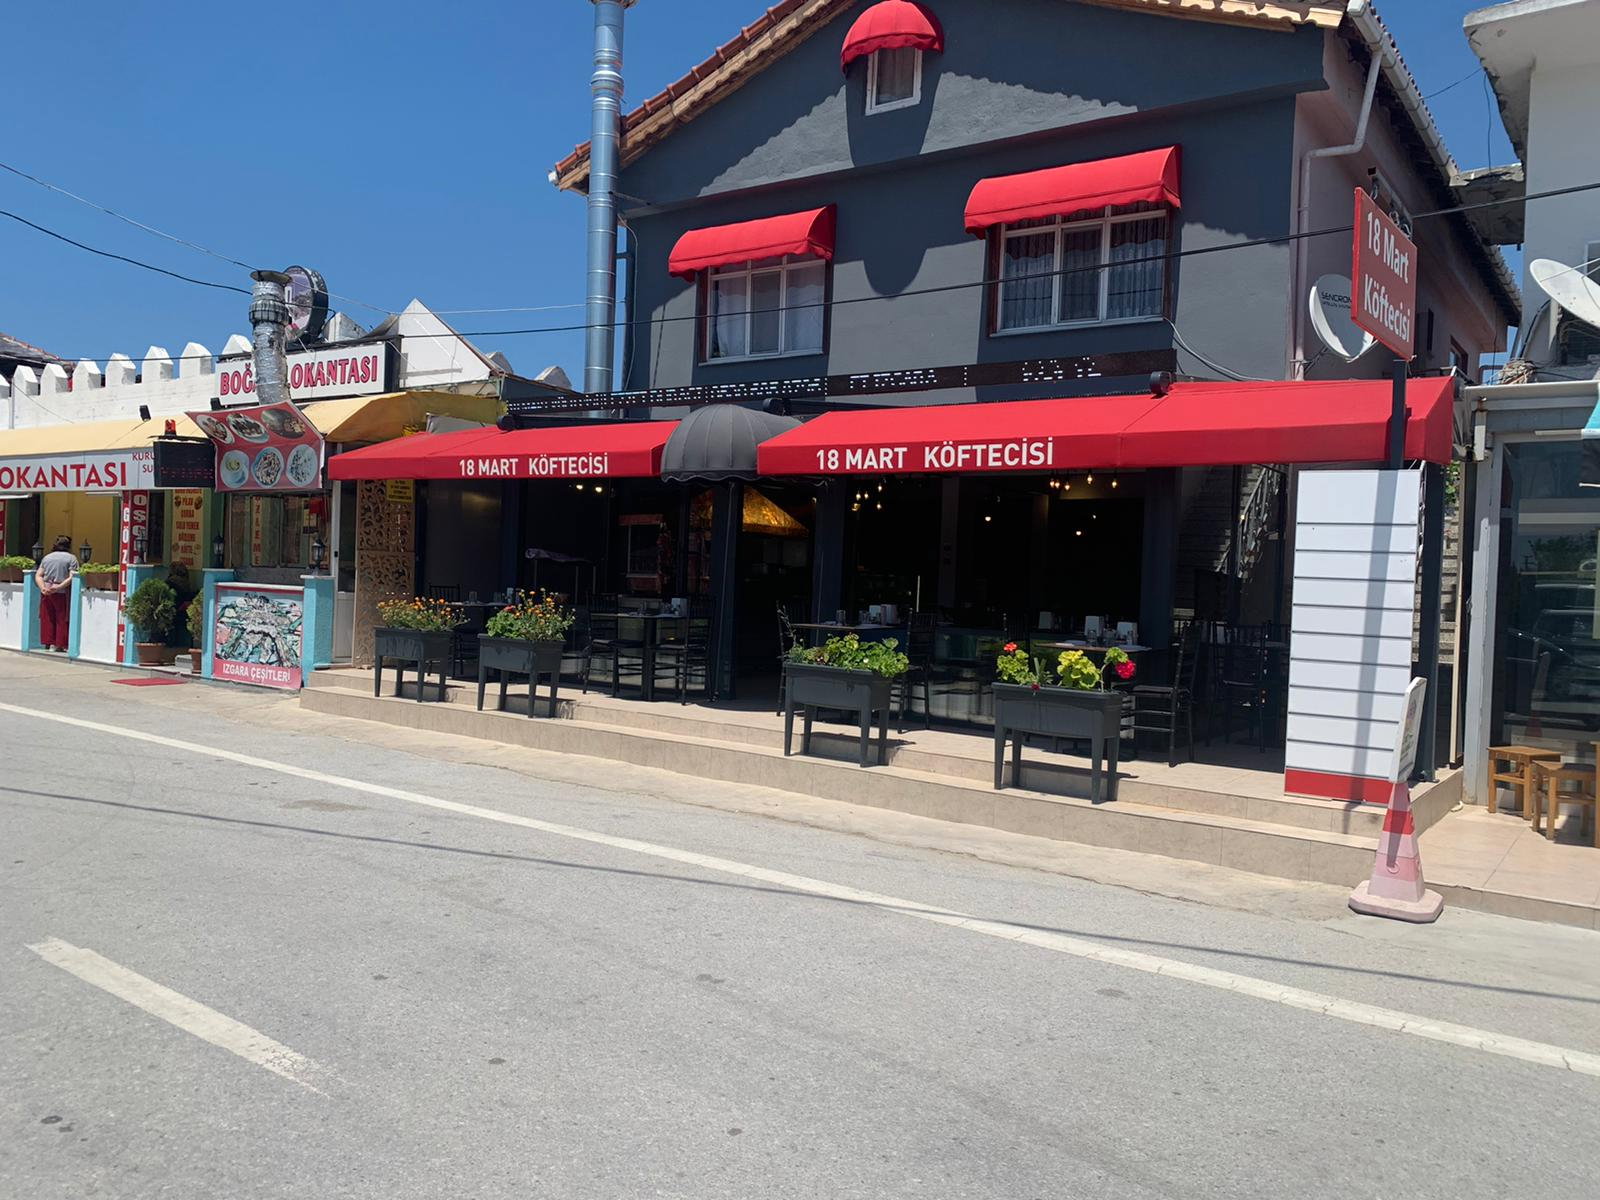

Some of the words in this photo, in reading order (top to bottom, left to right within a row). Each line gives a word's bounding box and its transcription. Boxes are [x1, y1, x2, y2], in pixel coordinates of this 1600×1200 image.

[1367, 211, 1381, 256] 18
[1383, 228, 1409, 284] Mart
[1364, 273, 1410, 342] Köftecisi
[287, 355, 378, 390] OKANTASI
[459, 459, 475, 476] 18
[478, 458, 519, 476] MART
[528, 452, 608, 475] KÖFTECİSİ
[817, 449, 839, 470] 18
[845, 447, 908, 470] MART
[924, 437, 1054, 468] KÖFTECİSİ
[222, 663, 249, 677] IZGARA
[250, 666, 291, 684] ÇEŞİTLERİ
